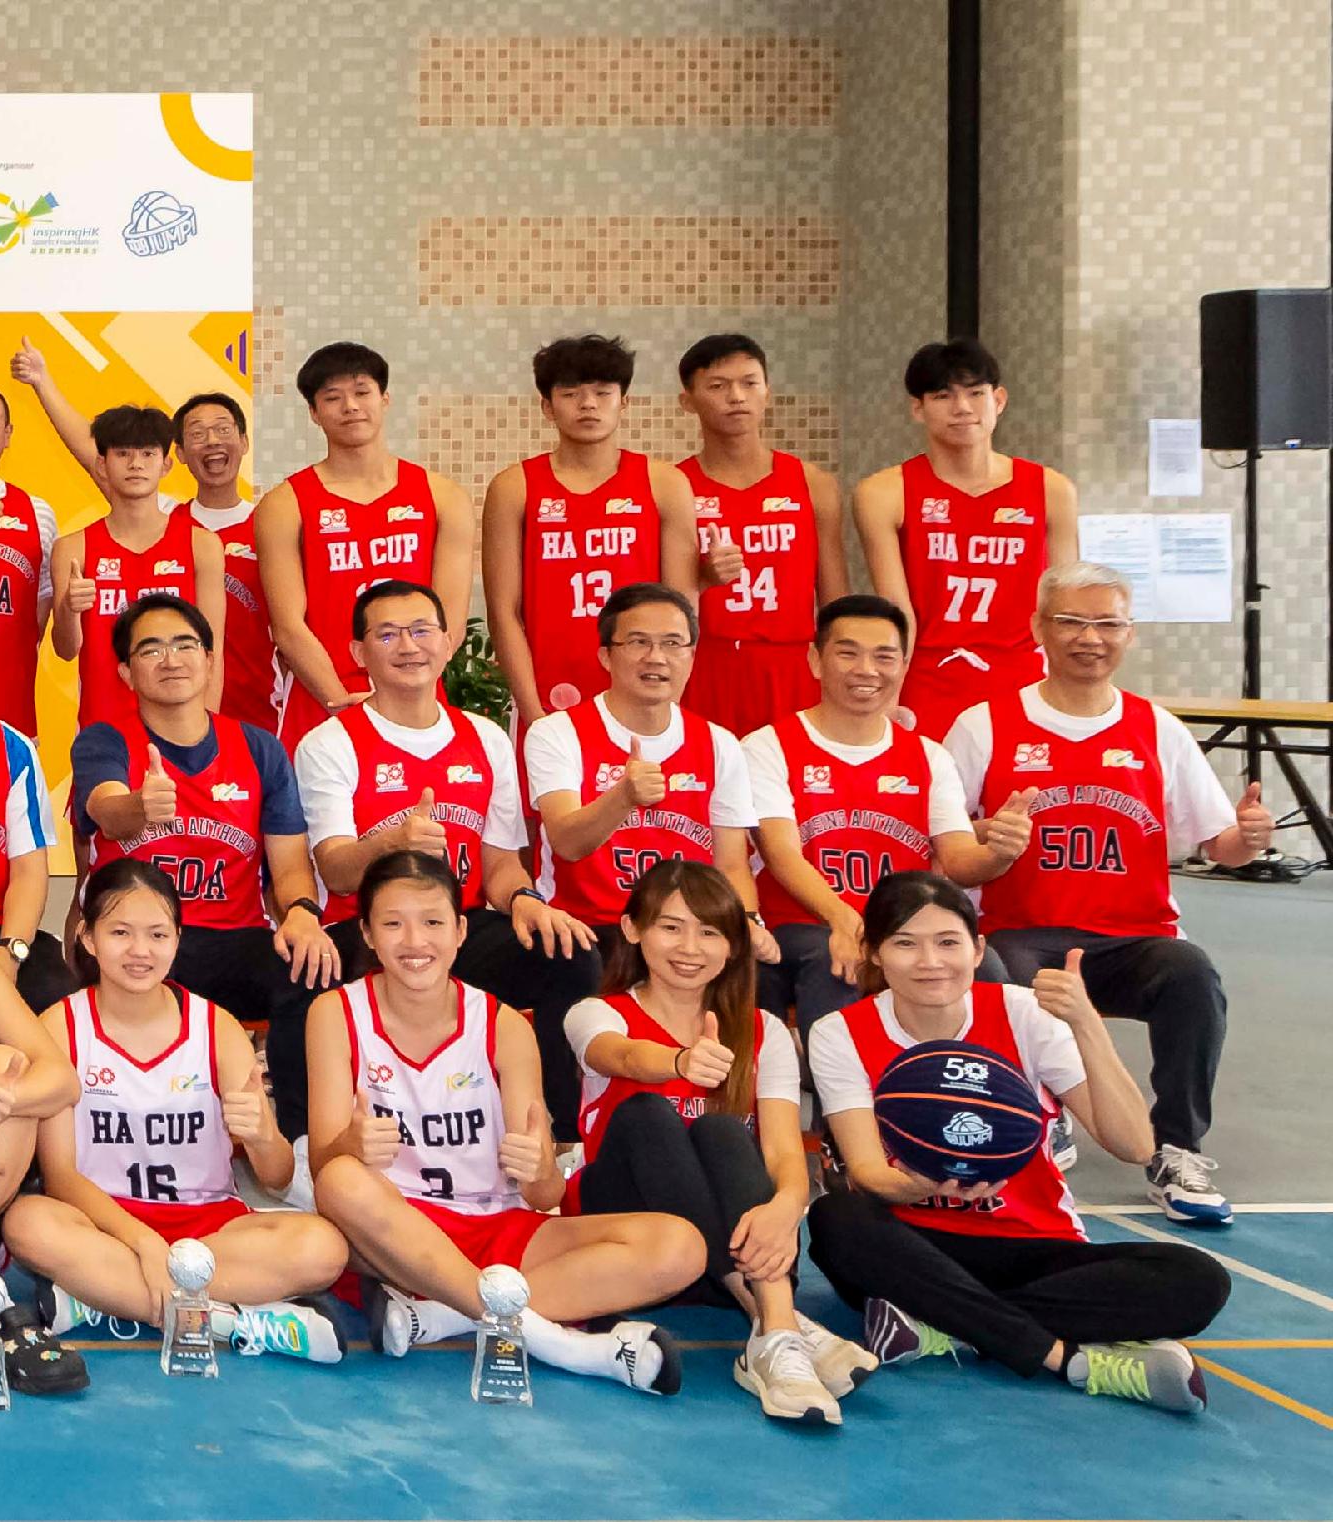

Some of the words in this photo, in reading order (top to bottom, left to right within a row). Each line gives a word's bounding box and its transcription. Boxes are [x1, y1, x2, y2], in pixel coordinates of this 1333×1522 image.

[328, 540, 361, 572] HA
[370, 533, 419, 565] CUP
[541, 531, 577, 560] HA
[585, 527, 636, 556] CUP
[743, 524, 797, 554] CUP
[928, 532, 959, 561] HA
[967, 535, 1025, 566] CUP
[569, 570, 612, 618] 13
[725, 566, 779, 612] 34
[944, 576, 998, 623] 77
[1072, 785, 1163, 835] AUTHORITY
[90, 1109, 133, 1144] HA
[145, 1110, 206, 1145] CUP
[422, 1107, 486, 1146] CUP
